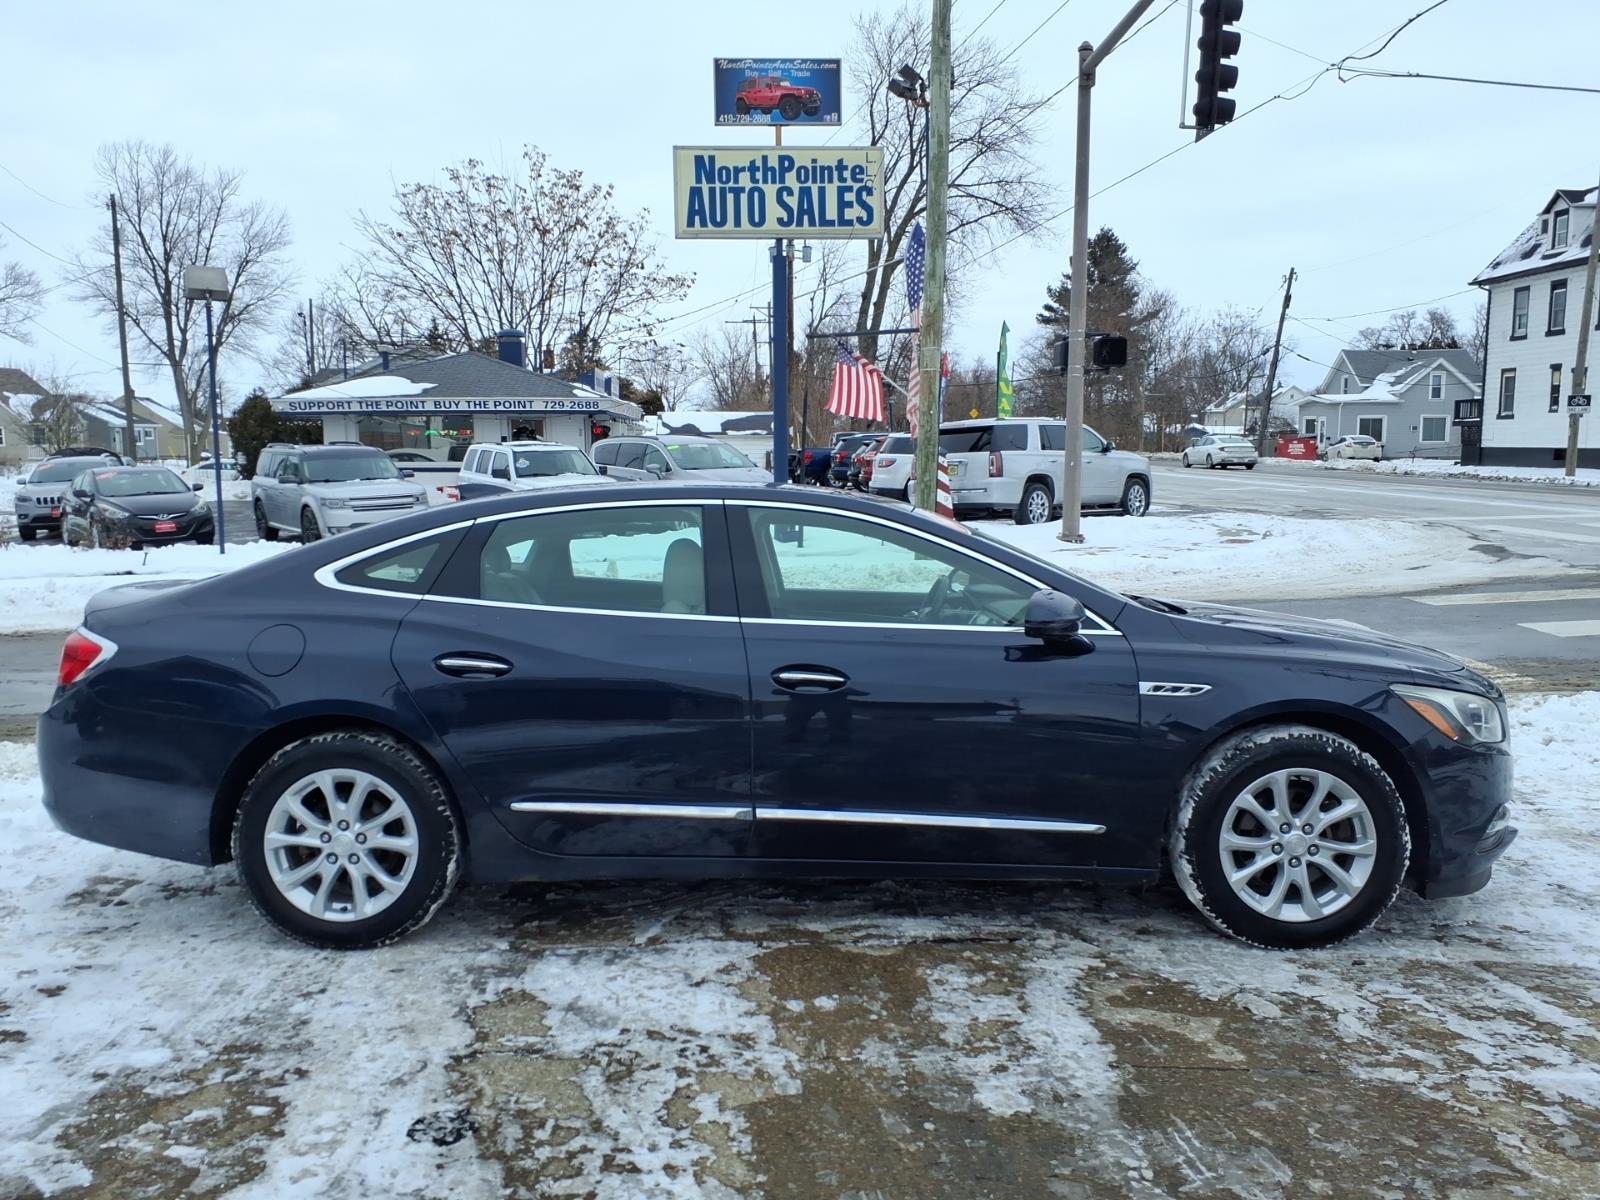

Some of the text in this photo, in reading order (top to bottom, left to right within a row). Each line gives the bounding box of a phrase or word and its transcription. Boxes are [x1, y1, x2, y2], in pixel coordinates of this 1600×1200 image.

[694, 155, 865, 185] NorthPointe
[686, 185, 874, 228] AUTO SALES
[288, 400, 600, 411] SUPPORT THE POINT BUY THE POINT 729-2688
